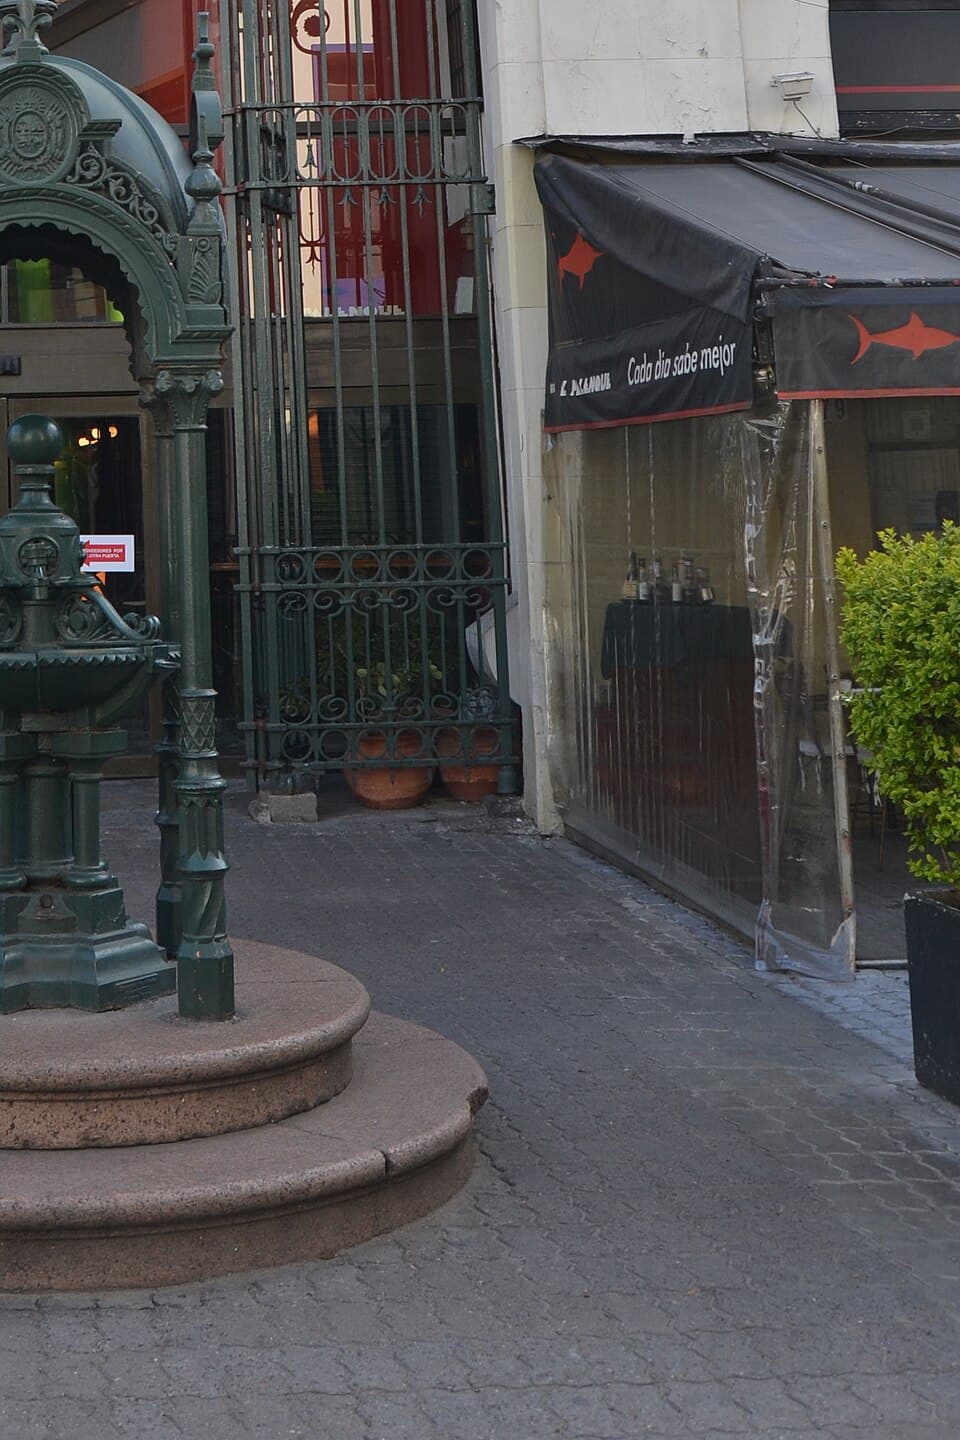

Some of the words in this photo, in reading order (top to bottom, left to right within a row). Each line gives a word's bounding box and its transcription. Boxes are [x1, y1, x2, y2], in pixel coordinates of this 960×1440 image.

[627, 353, 652, 386] Cada
[672, 342, 697, 377] sabe
[700, 335, 737, 376] mejor
